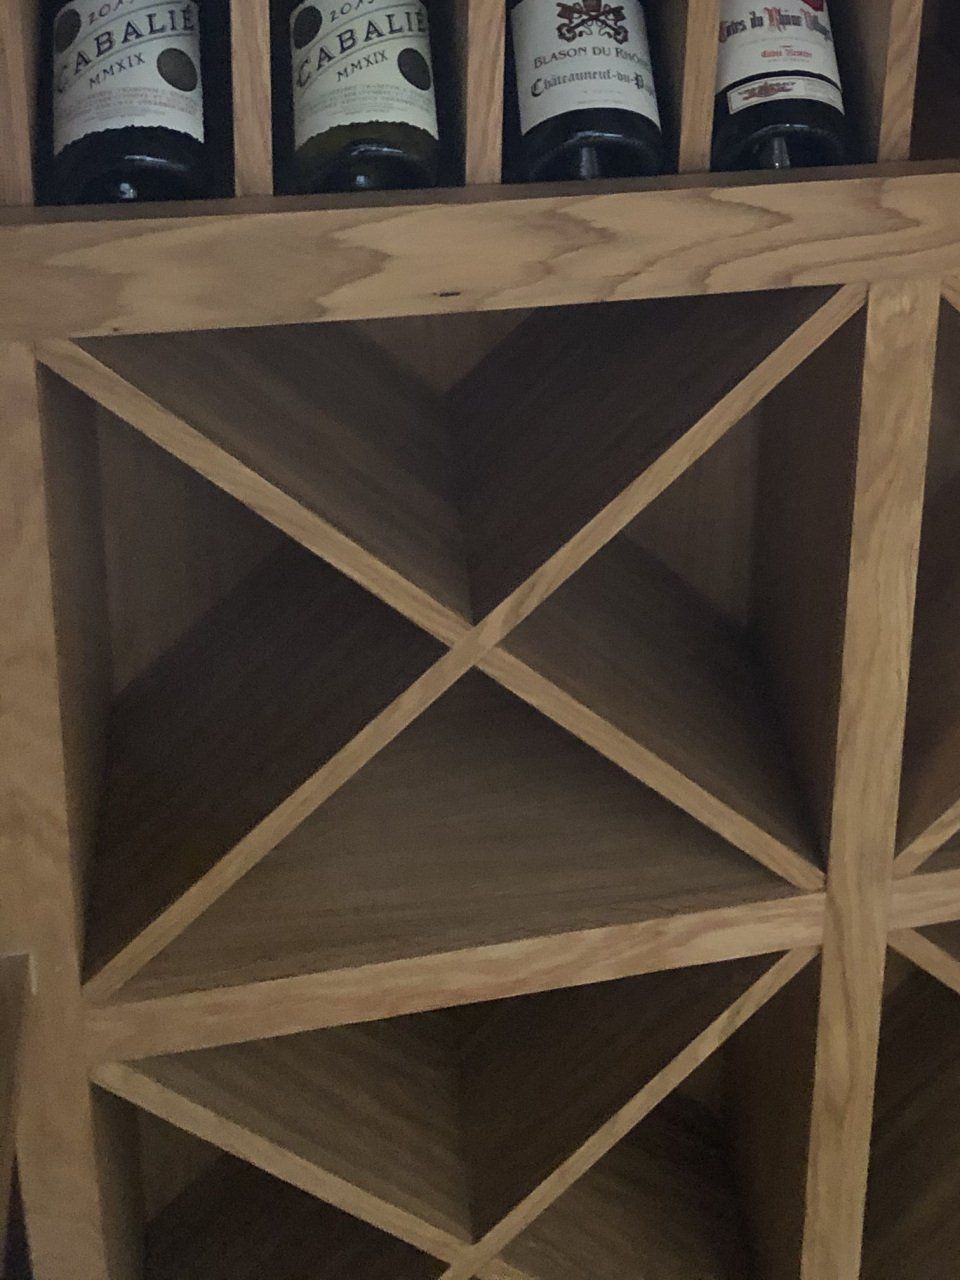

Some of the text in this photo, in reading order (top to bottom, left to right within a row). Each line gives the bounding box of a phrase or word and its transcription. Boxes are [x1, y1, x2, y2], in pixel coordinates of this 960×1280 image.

[88, 52, 146, 89] MMXIX
[336, 50, 389, 83] MMXIX
[534, 46, 587, 70] BLASON
[592, 46, 612, 56] DU
